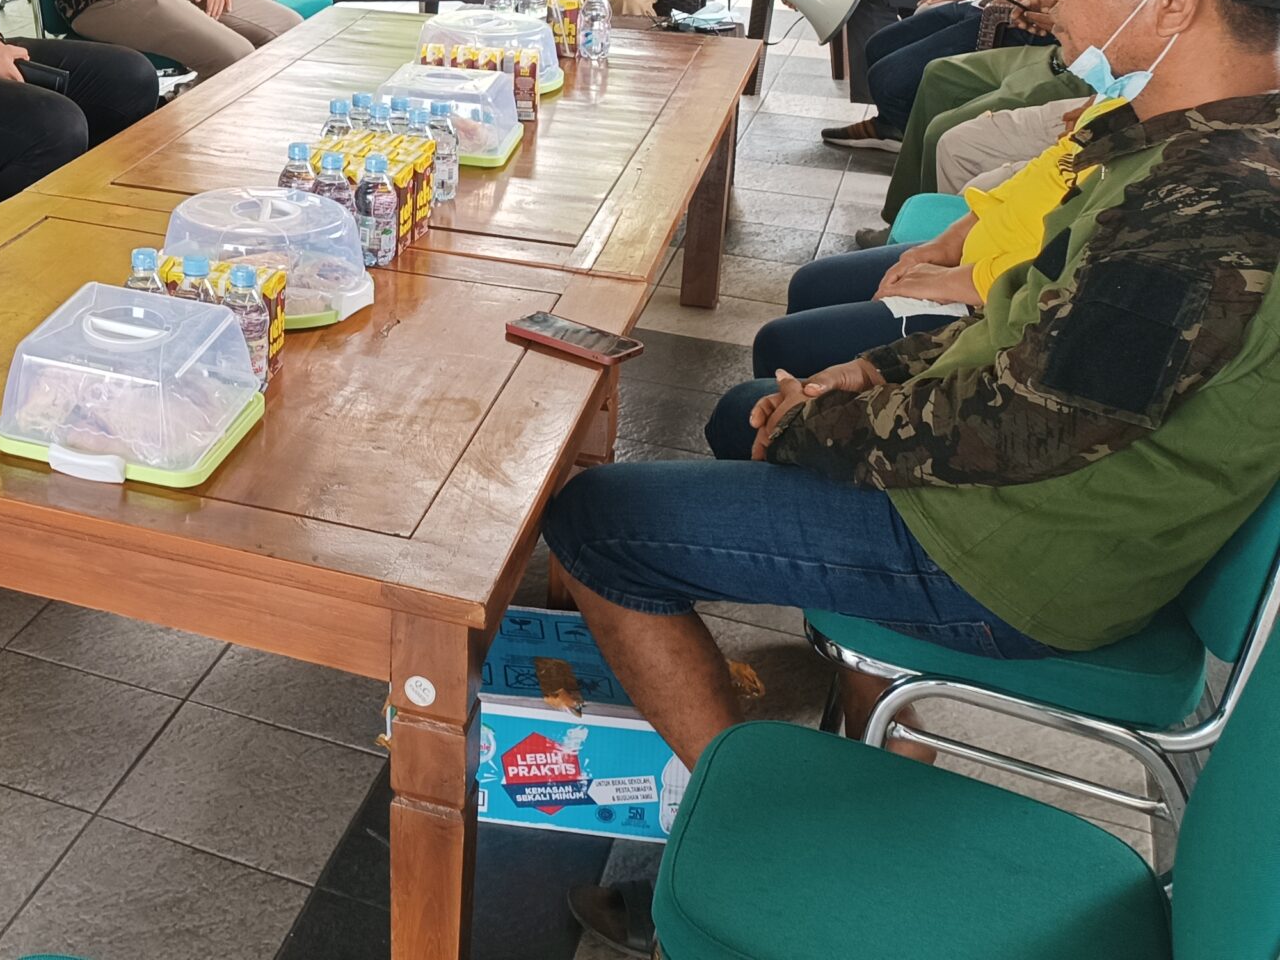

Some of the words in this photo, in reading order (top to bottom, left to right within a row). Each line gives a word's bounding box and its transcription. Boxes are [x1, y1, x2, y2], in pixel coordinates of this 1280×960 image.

[516, 752, 564, 766] LEBIH
[508, 764, 577, 778] PRAKTIS
[525, 785, 573, 794] KEMASAN
[516, 792, 550, 802] SEKALI
[628, 807, 645, 820] SNI
